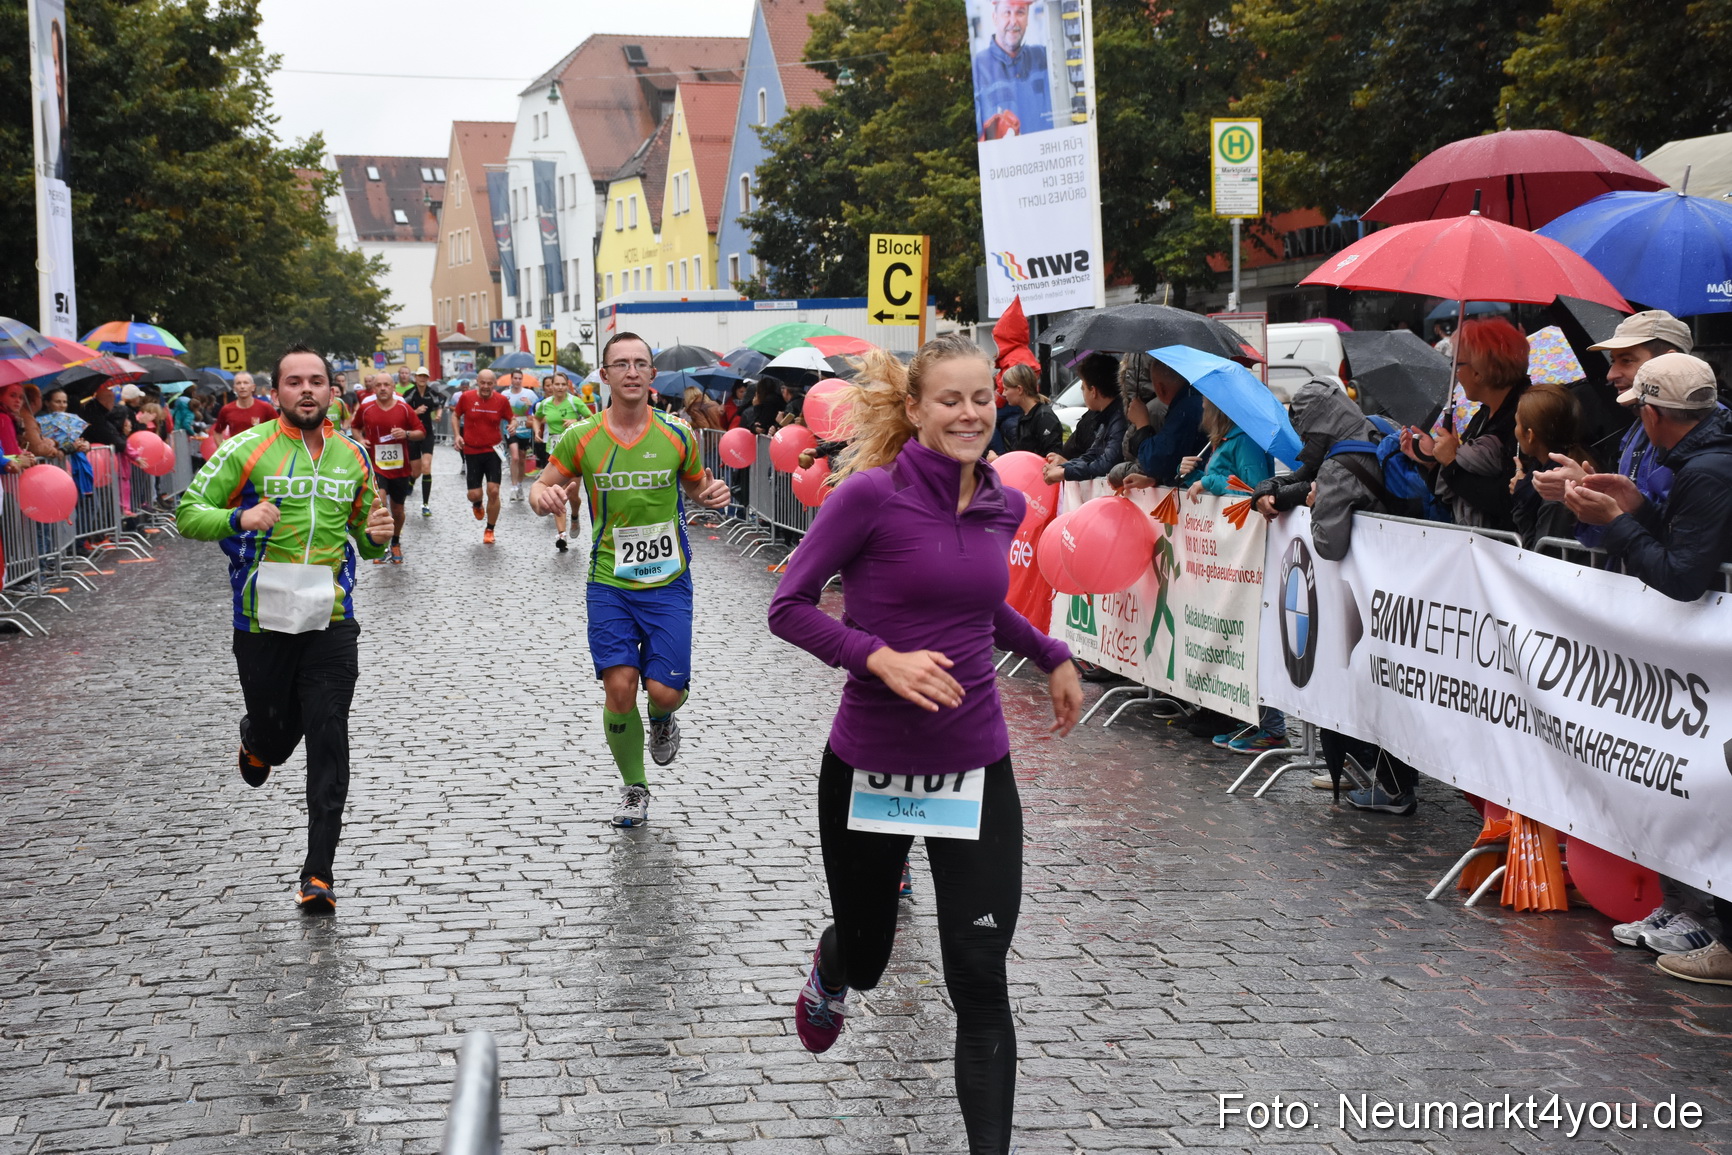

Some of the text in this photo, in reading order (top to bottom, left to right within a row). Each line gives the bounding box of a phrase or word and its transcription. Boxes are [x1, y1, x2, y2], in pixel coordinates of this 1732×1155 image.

[1221, 167, 1252, 175] Marktplatz
[877, 238, 921, 256] Block
[883, 262, 913, 306] C
[226, 346, 239, 363] D
[541, 340, 552, 357] D
[381, 450, 398, 460] 233
[263, 476, 357, 502] BOCK
[593, 469, 672, 491] BOCK
[622, 535, 673, 564] 2859
[634, 566, 662, 576] Tobias
[1184, 603, 1245, 643] Gebäudereinigung
[1370, 589, 1424, 648] BMW
[1184, 635, 1245, 671] Hausmeisterdienst
[1184, 667, 1250, 707] Arbeitsbühnenverleih
[1369, 653, 1690, 799] WENIGER VERBRAUCH. MEHR FAHRFREUDE.
[888, 797, 926, 819] Julia
